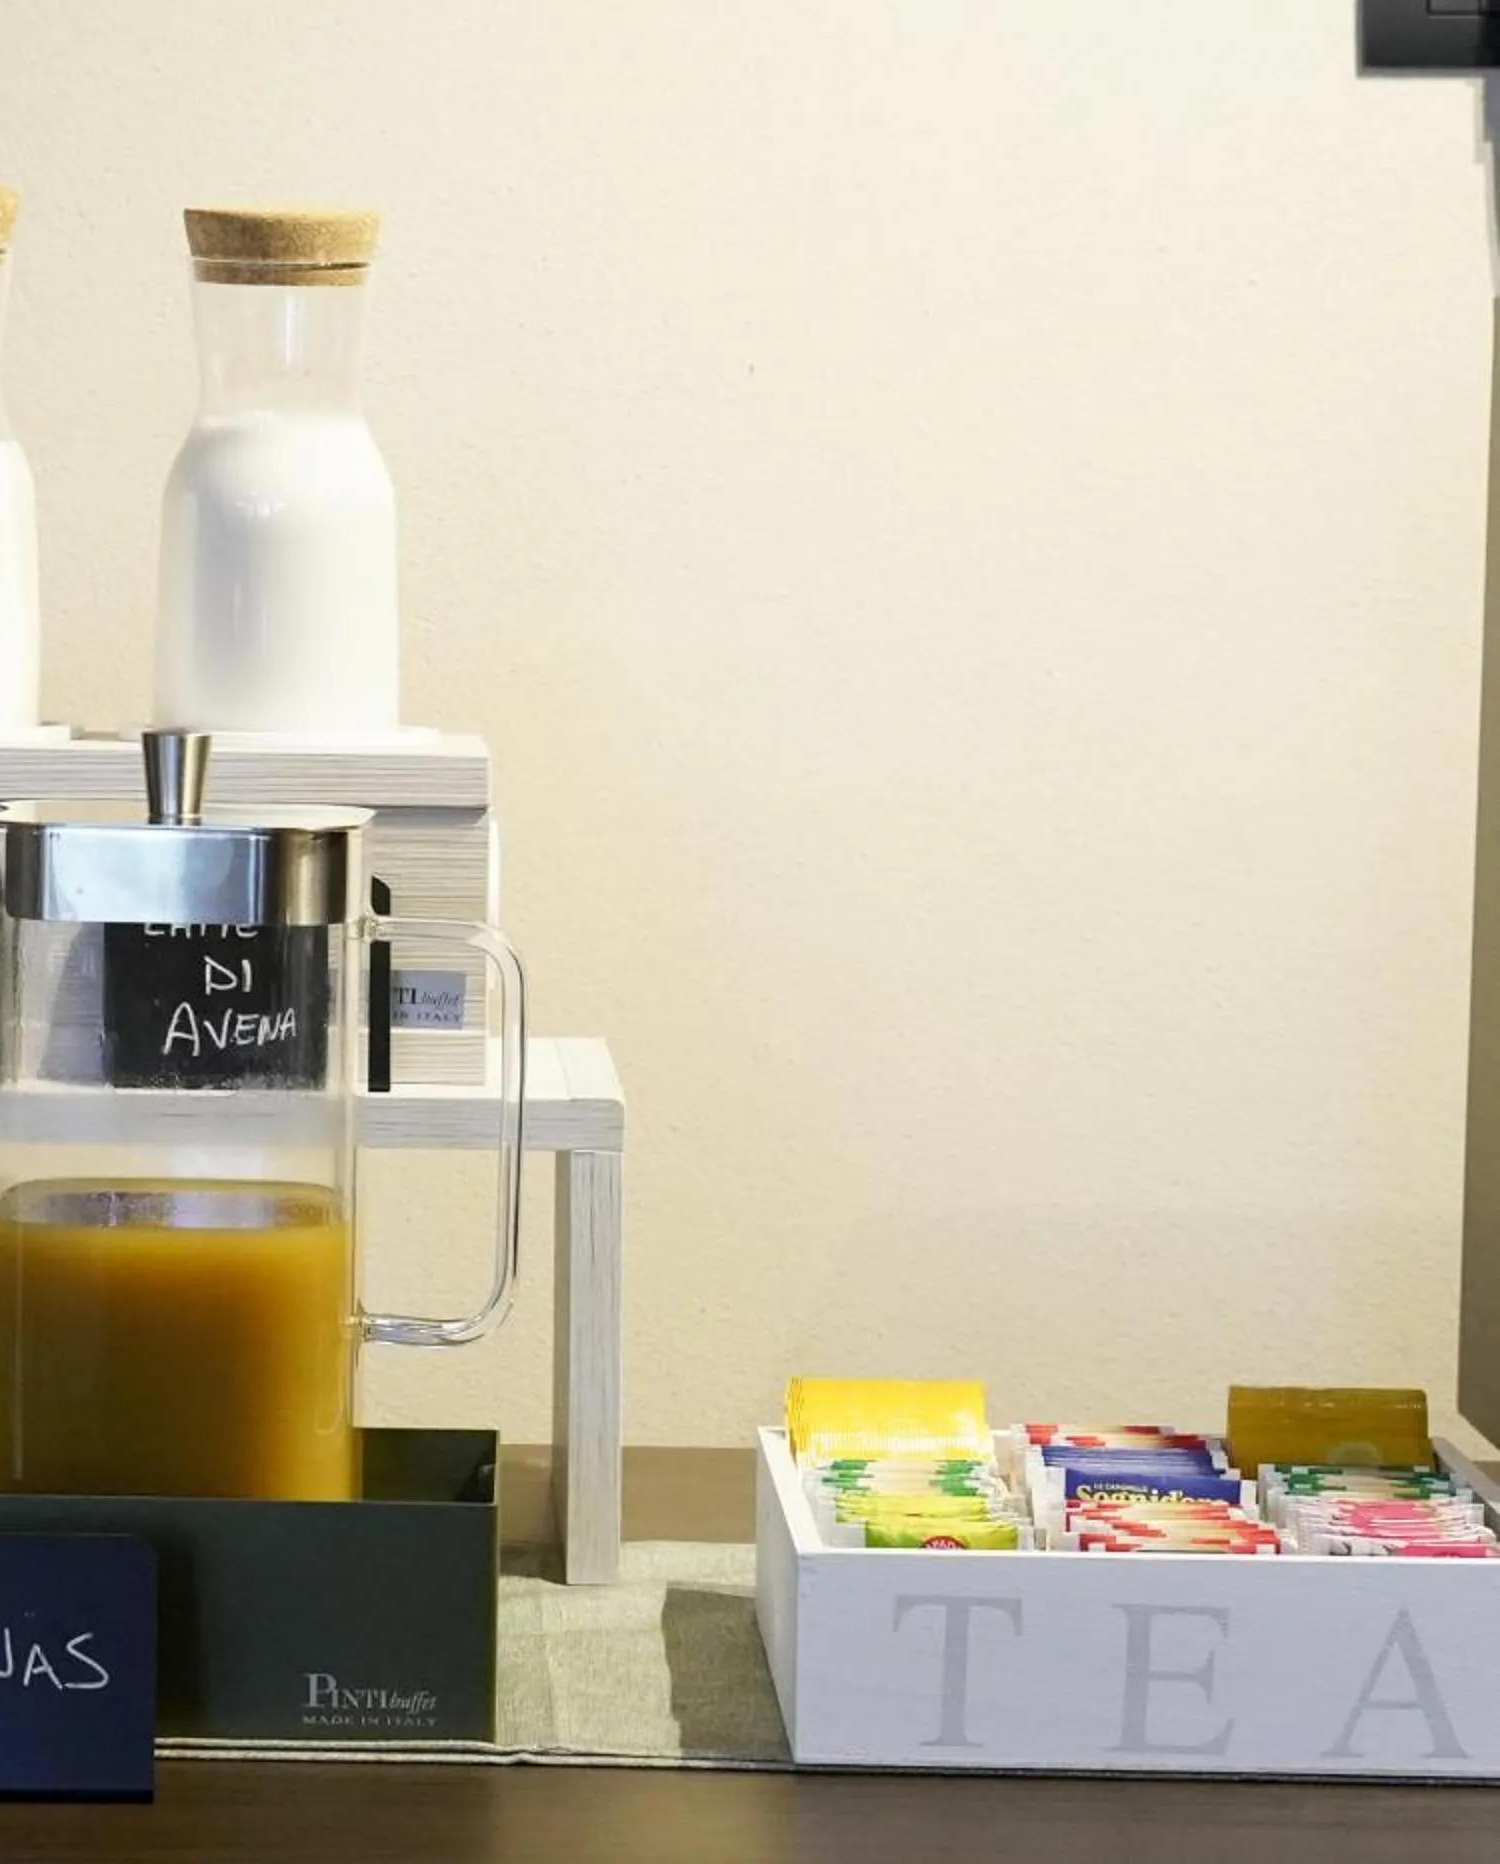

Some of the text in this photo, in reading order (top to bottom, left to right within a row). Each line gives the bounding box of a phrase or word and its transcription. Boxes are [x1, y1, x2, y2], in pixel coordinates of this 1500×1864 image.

[204, 955, 252, 995] DI
[162, 1001, 297, 1056] AVENA
[891, 1594, 1470, 1760] TEA
